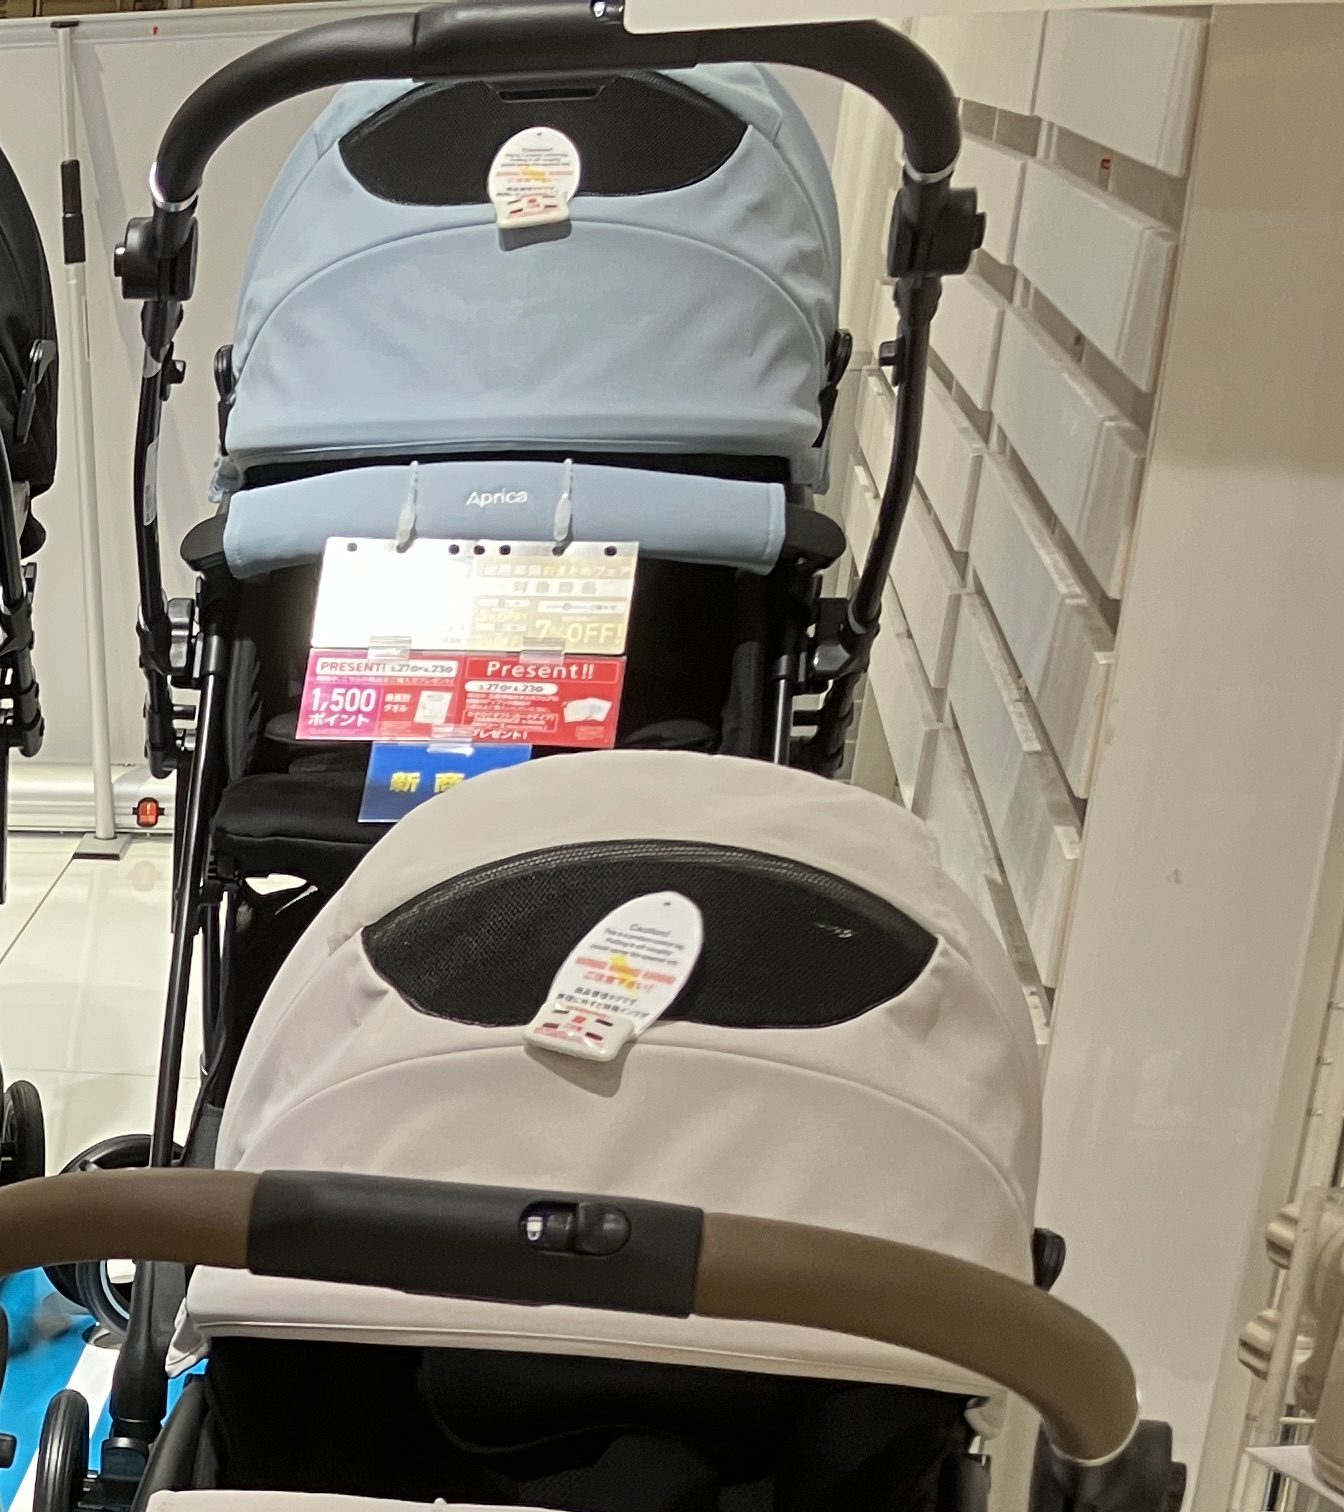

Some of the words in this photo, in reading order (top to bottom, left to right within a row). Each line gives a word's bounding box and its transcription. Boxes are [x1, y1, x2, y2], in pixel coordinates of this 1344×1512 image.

[466, 489, 528, 507] Aprica
[535, 618, 624, 645] 7%OFF!
[320, 661, 385, 673] PRESENT!
[486, 661, 594, 680] Present!!
[312, 687, 376, 713] 1,500
[308, 712, 370, 727] ポイント
